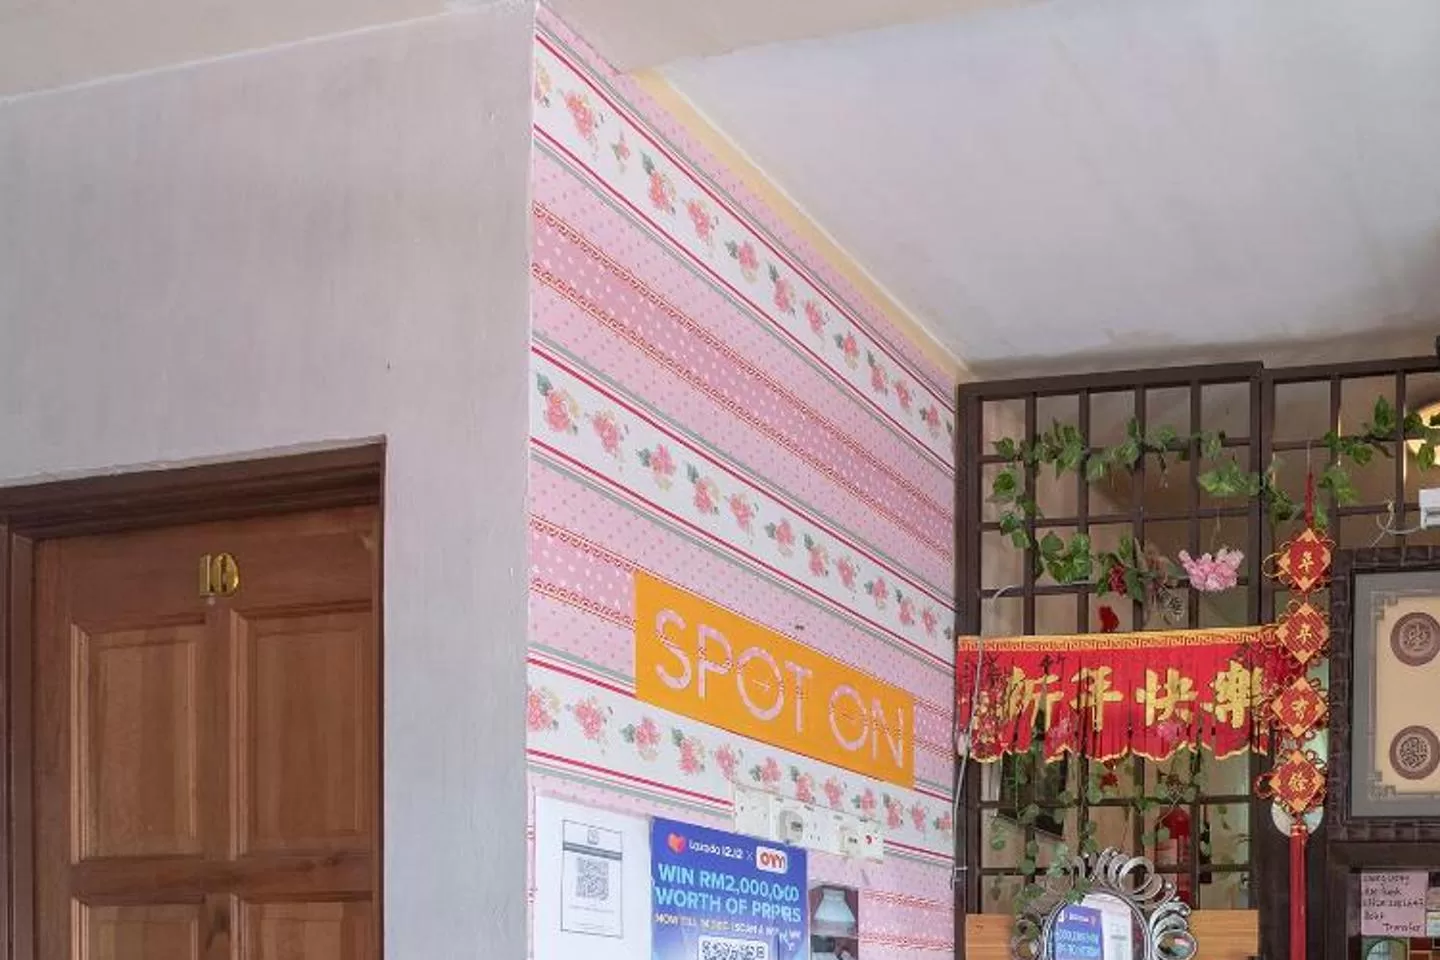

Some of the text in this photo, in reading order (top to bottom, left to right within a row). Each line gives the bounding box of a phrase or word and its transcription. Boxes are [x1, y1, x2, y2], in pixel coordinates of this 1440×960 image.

[654, 609, 904, 768] SPOT ON
[658, 862, 694, 885] WIN
[655, 887, 722, 913] WORTH
[725, 897, 748, 915] OF
